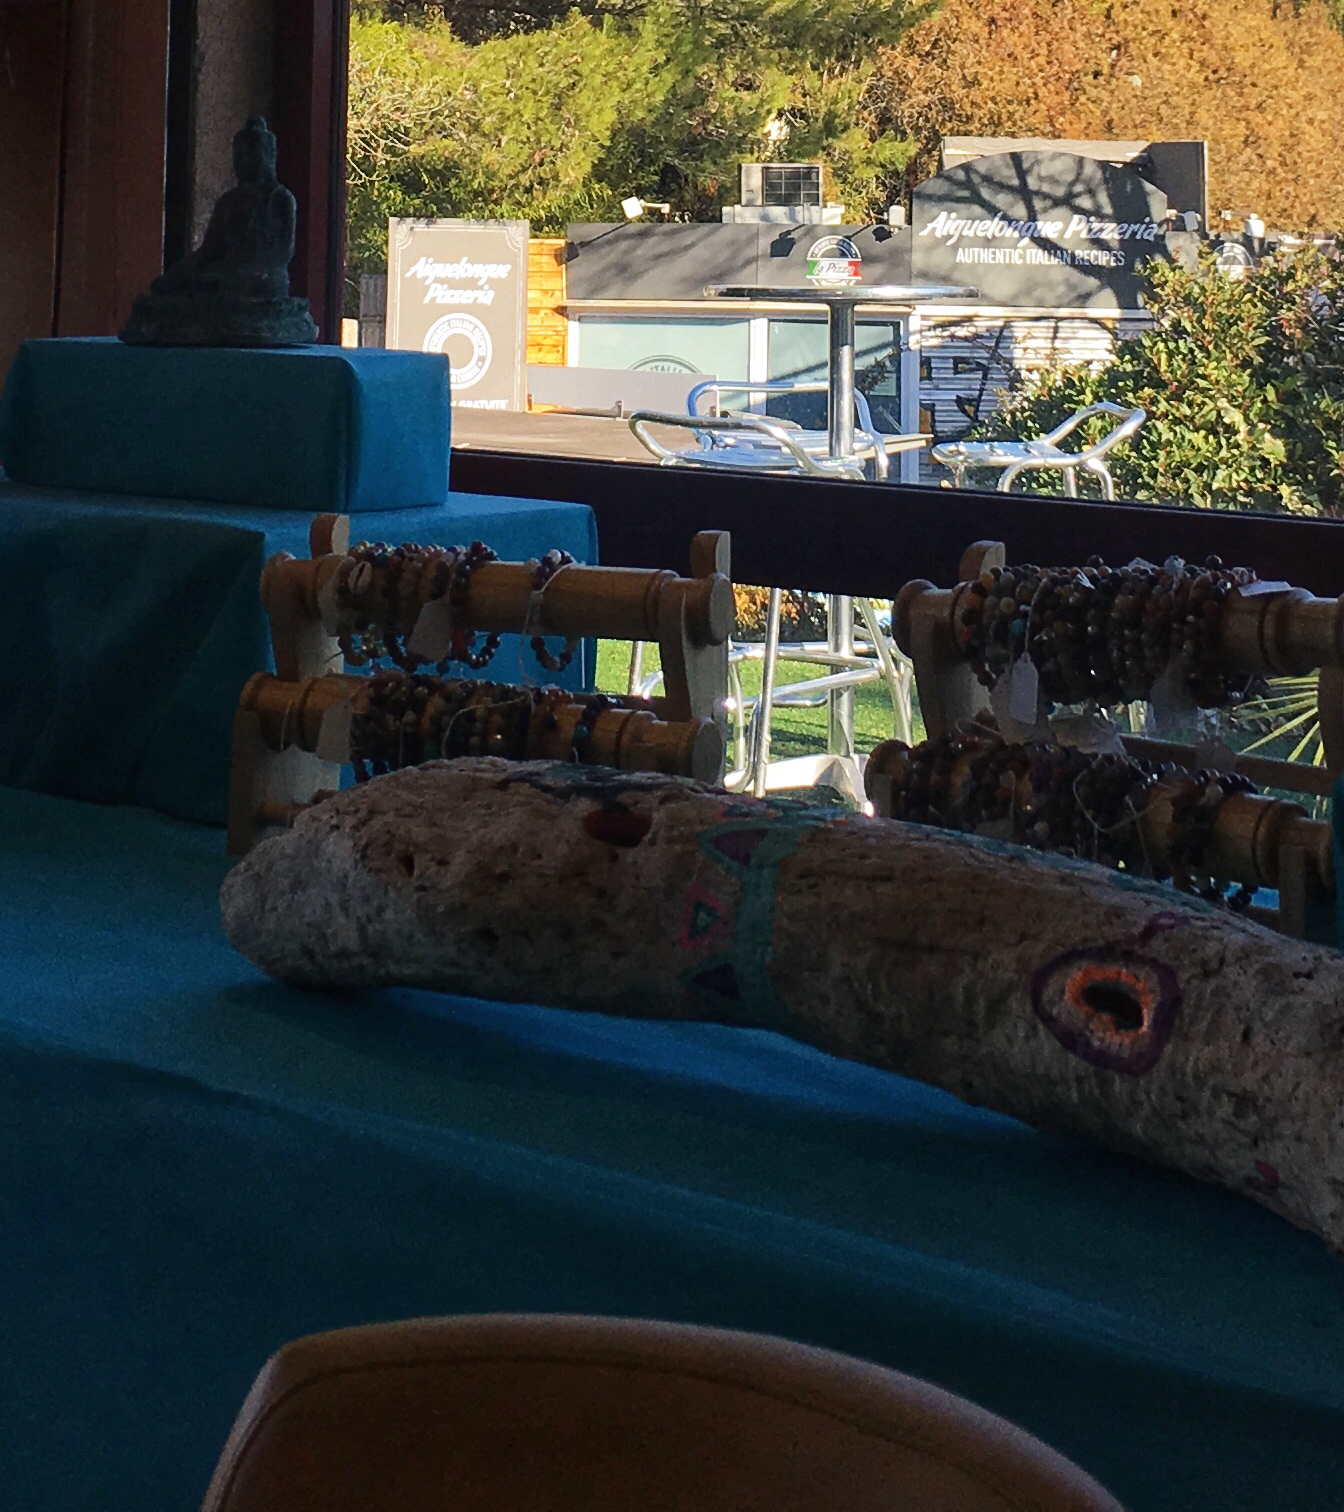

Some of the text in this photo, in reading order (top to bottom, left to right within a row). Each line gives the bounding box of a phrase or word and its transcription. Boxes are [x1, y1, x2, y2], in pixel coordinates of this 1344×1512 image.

[918, 210, 1159, 248] Aiguelongue Pizzeria
[956, 247, 1126, 267] AUTHENTIC ITALIAN RECIPES
[405, 256, 512, 286] Aiguelongue
[422, 282, 496, 306] Pizzeria
